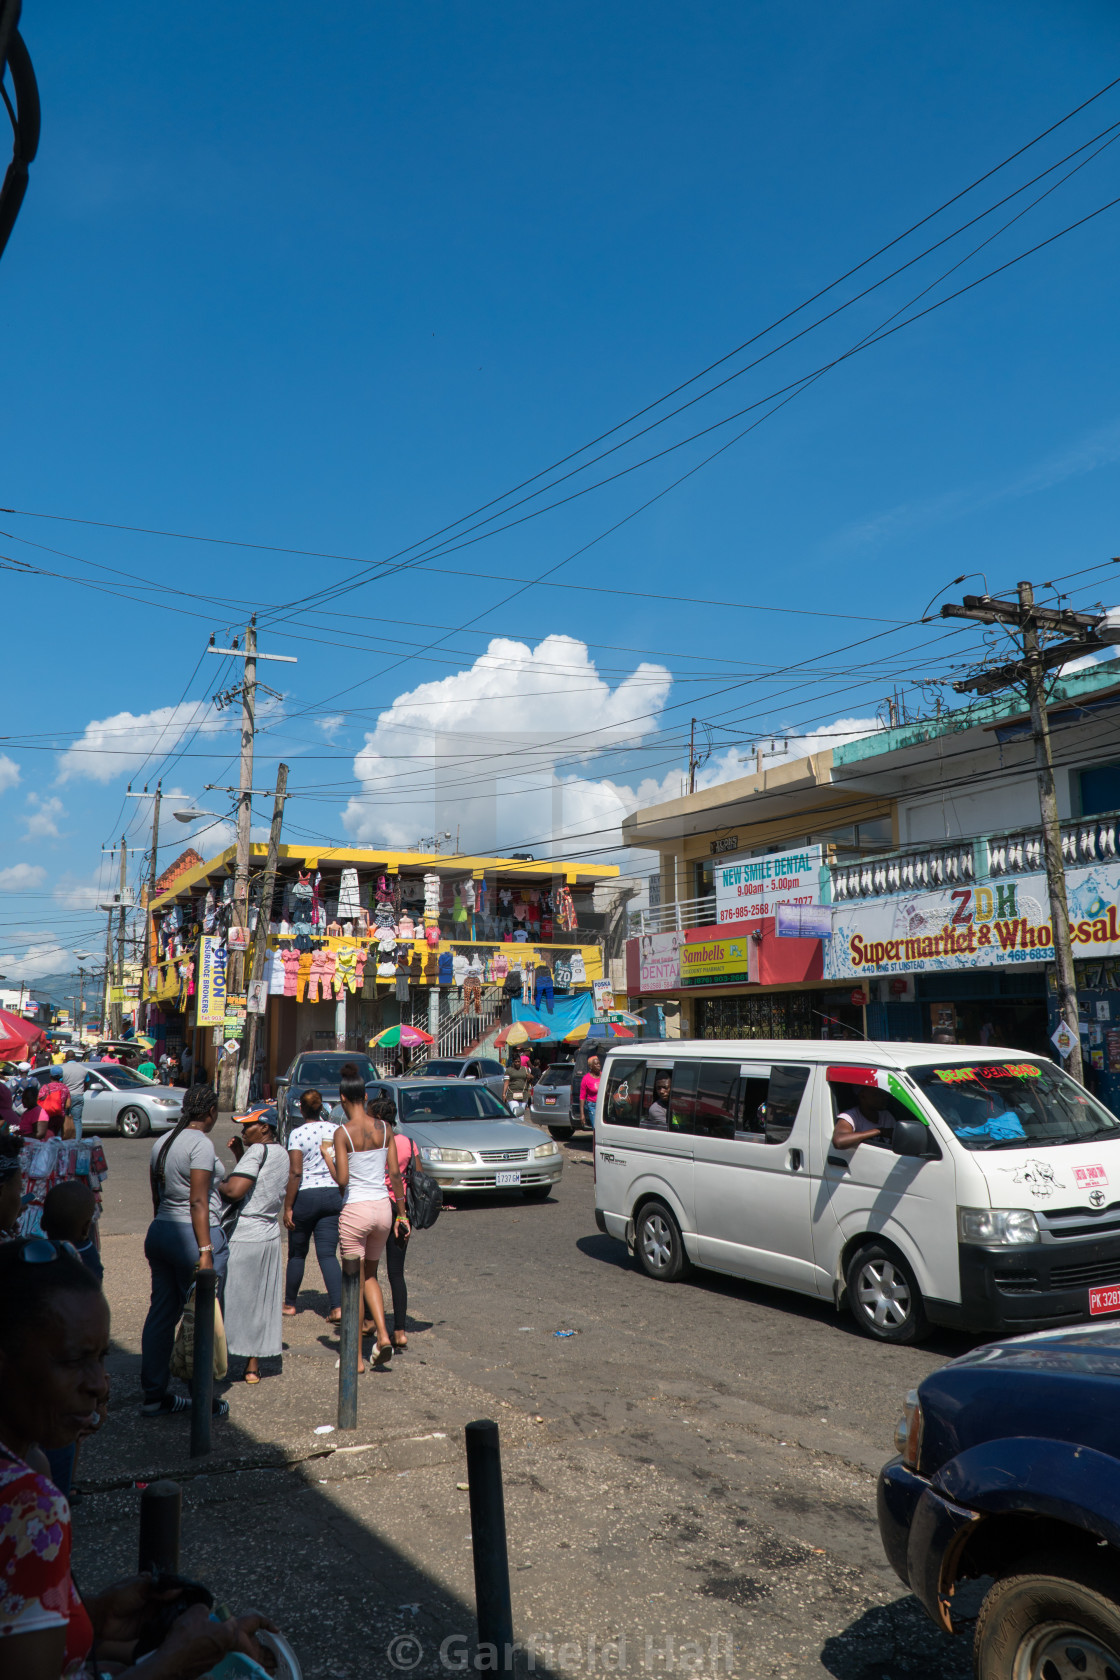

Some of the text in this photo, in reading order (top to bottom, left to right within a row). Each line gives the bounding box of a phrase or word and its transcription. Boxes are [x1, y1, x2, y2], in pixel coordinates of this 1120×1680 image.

[722, 853, 812, 887] NEW SMILE DENTAL
[737, 883, 764, 897] 9.00am
[771, 877, 800, 893] 5.00pm
[720, 903, 769, 921] 876-985-2568
[950, 883, 1018, 925] ZDH
[682, 944, 725, 964] Sambells
[850, 924, 977, 969] Supermarket
[977, 923, 992, 946] &
[1007, 947, 1055, 962] 468-6833
[201, 937, 212, 1014] INSURANCE BROKERS
[213, 948, 228, 998] ORION
[557, 969, 571, 982] 70
[861, 964, 875, 974] 440
[876, 962, 890, 973] KING
[899, 960, 925, 971] LINSTEAD
[933, 1067, 975, 1083] BEAT
[1003, 1063, 1042, 1078] BAD
[1091, 1293, 1102, 1309] PK
